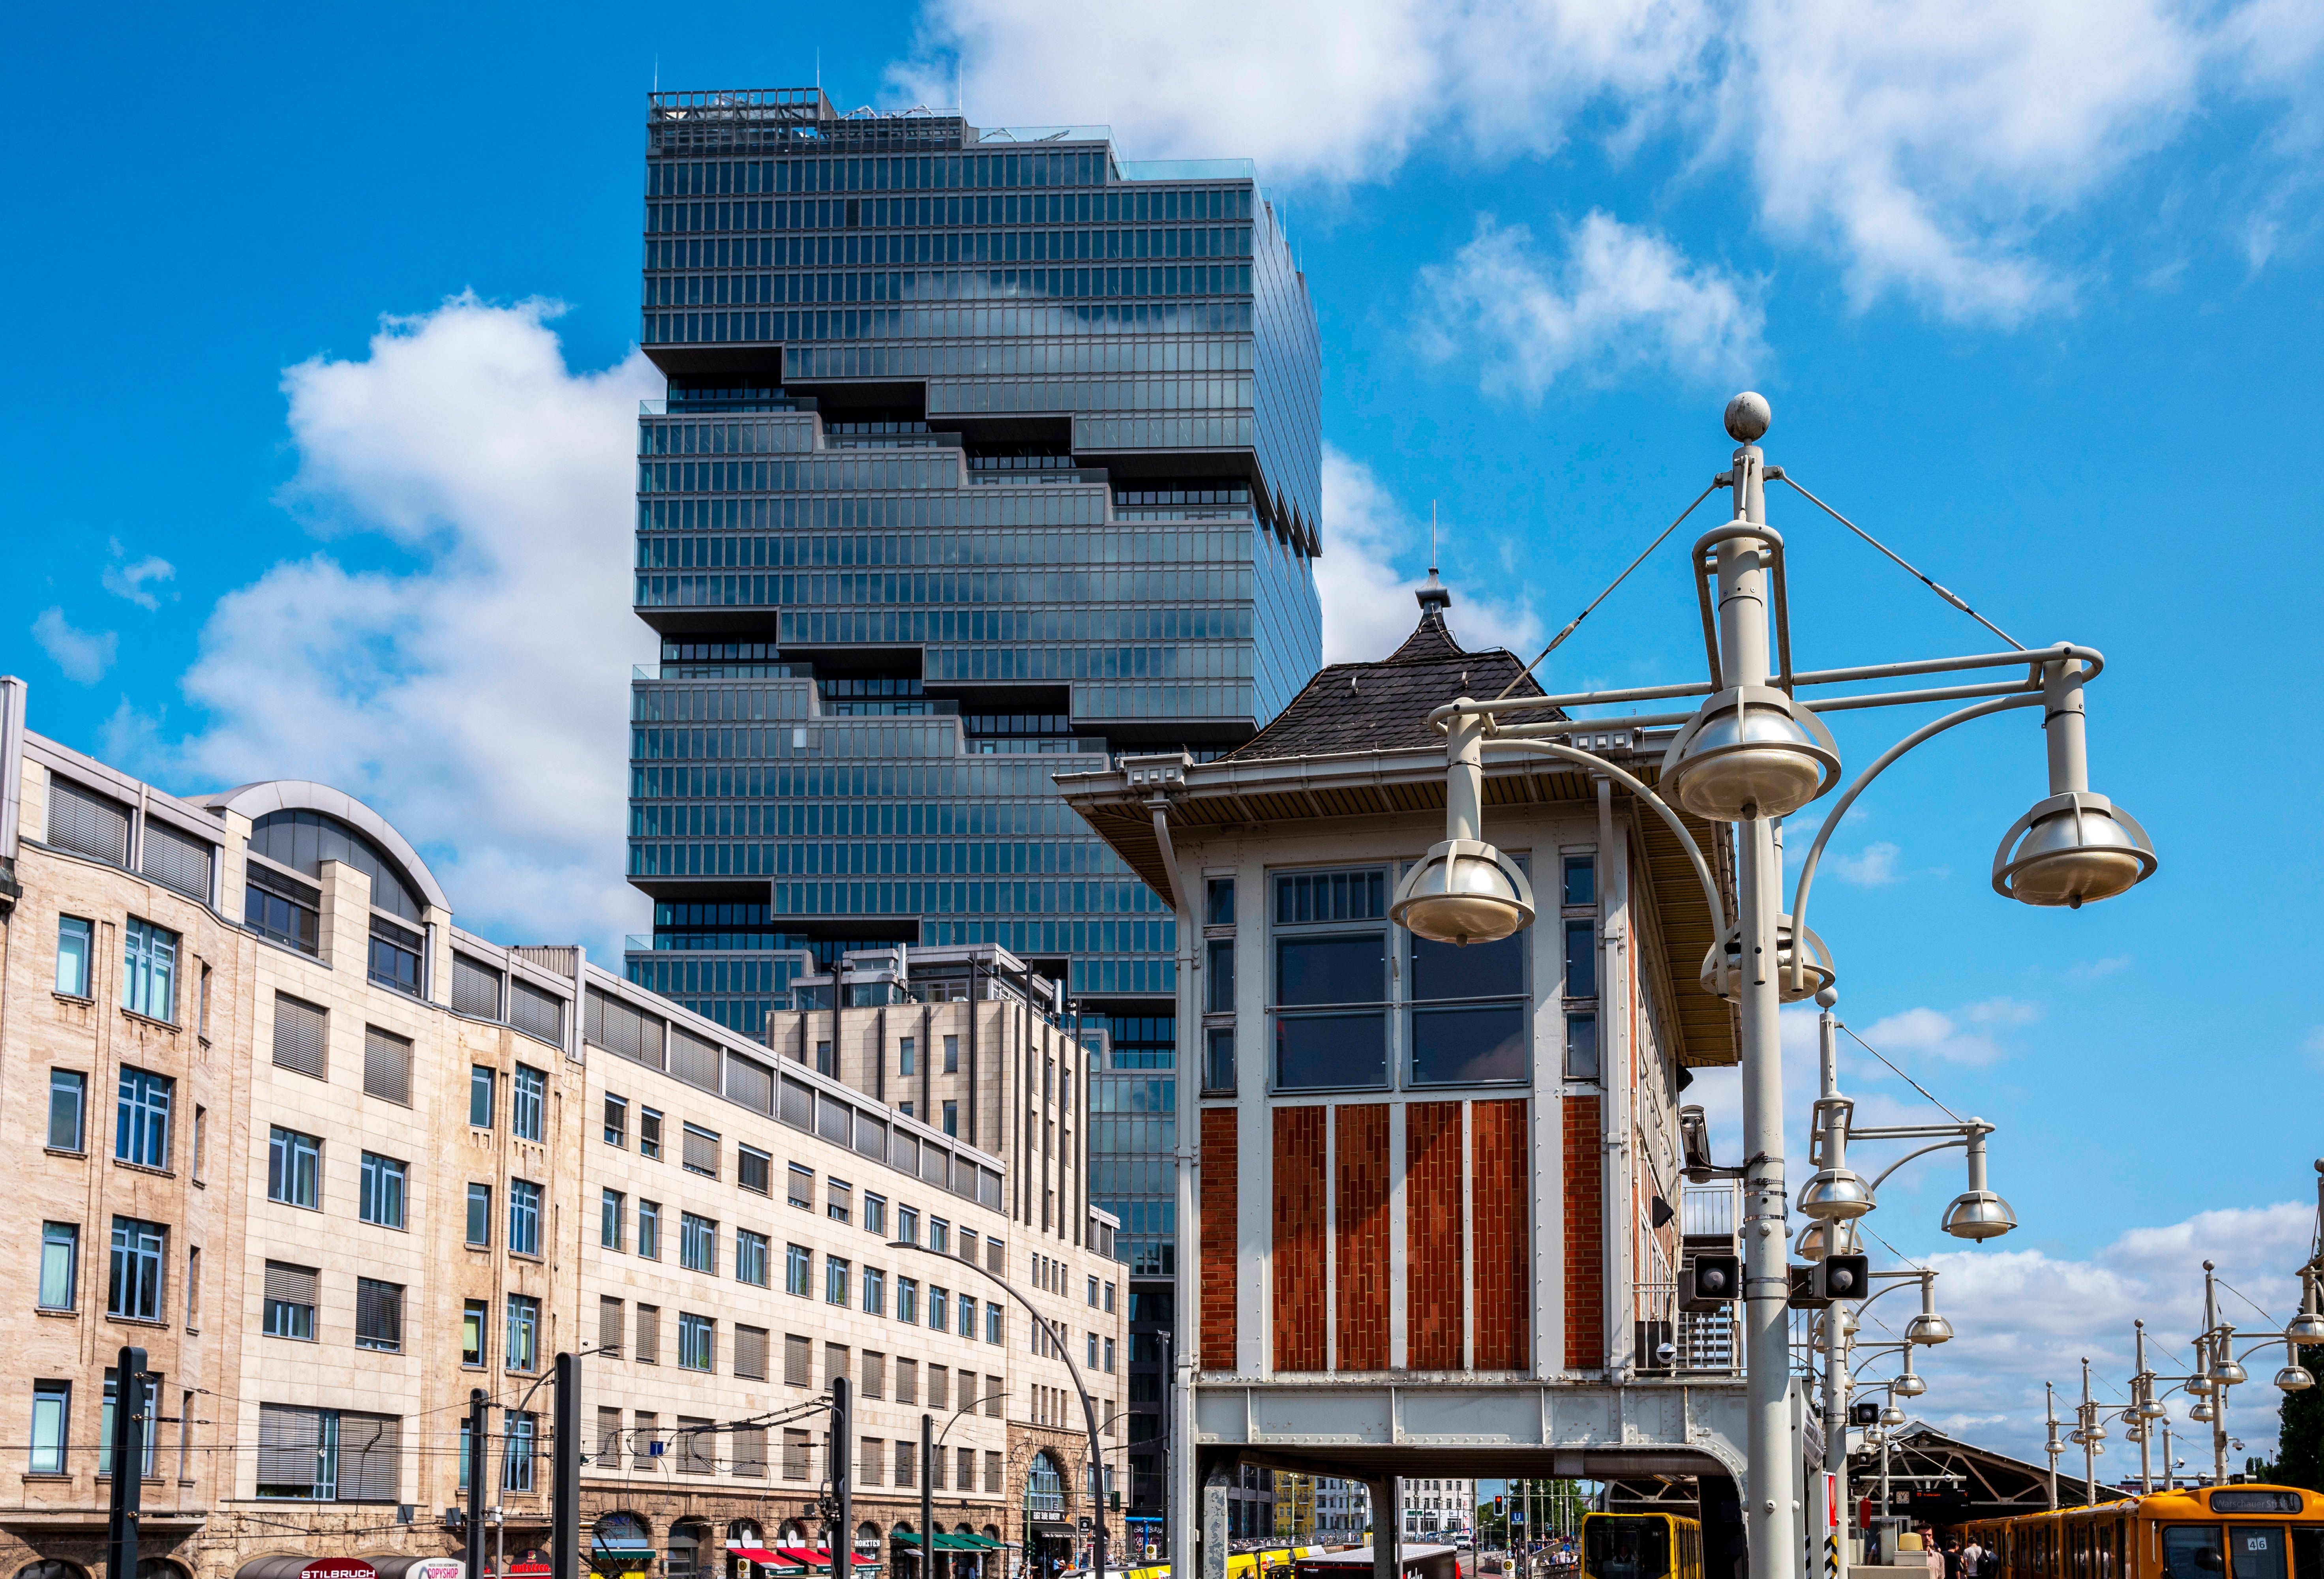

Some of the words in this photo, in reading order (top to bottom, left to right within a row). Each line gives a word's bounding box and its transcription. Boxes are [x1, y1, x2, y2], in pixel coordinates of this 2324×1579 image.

[2216, 1500, 2266, 1508] Warschauer
[301, 1570, 375, 1579] STILBRUCH
[428, 1568, 458, 1579] COPYSHOP
